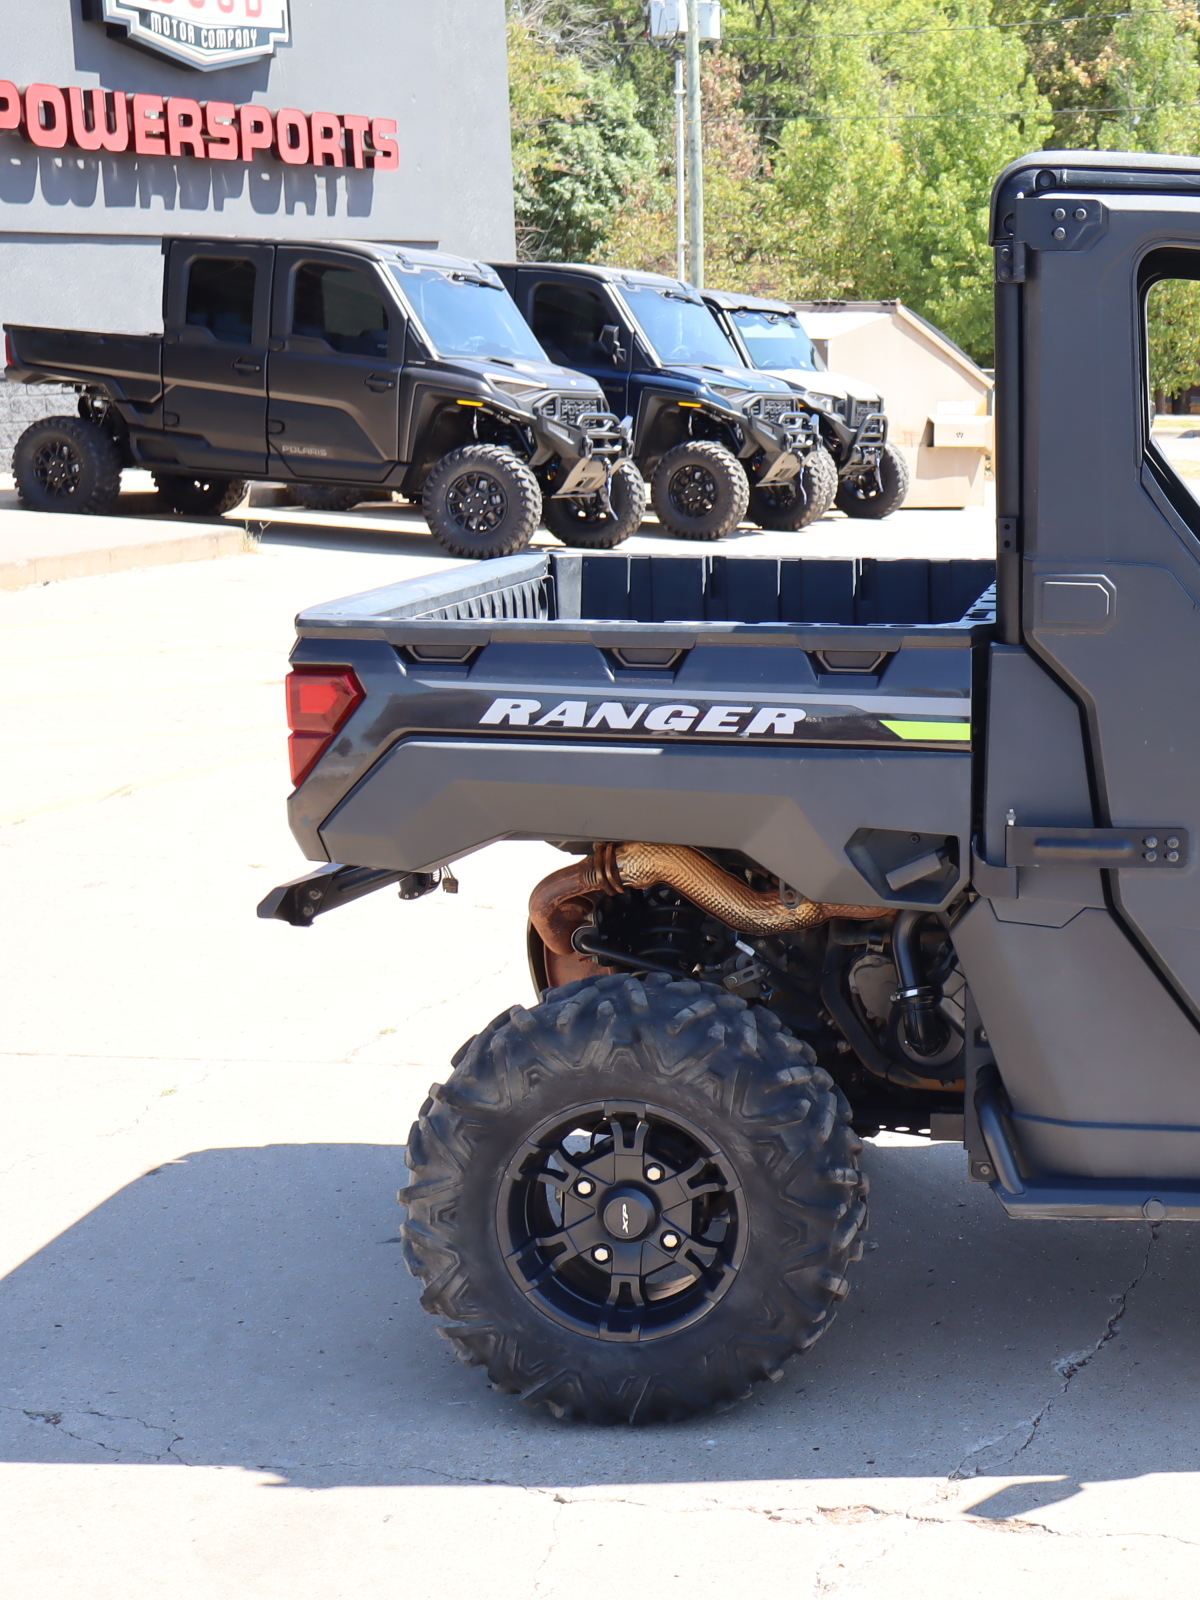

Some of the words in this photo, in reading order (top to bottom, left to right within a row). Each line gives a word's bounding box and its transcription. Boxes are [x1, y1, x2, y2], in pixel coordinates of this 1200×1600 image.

[150, 12, 195, 44] MOTOR
[201, 28, 257, 48] COMPANY
[282, 445, 328, 456] POLARIS
[478, 698, 806, 735] RANGER
[622, 1203, 629, 1234] XP
